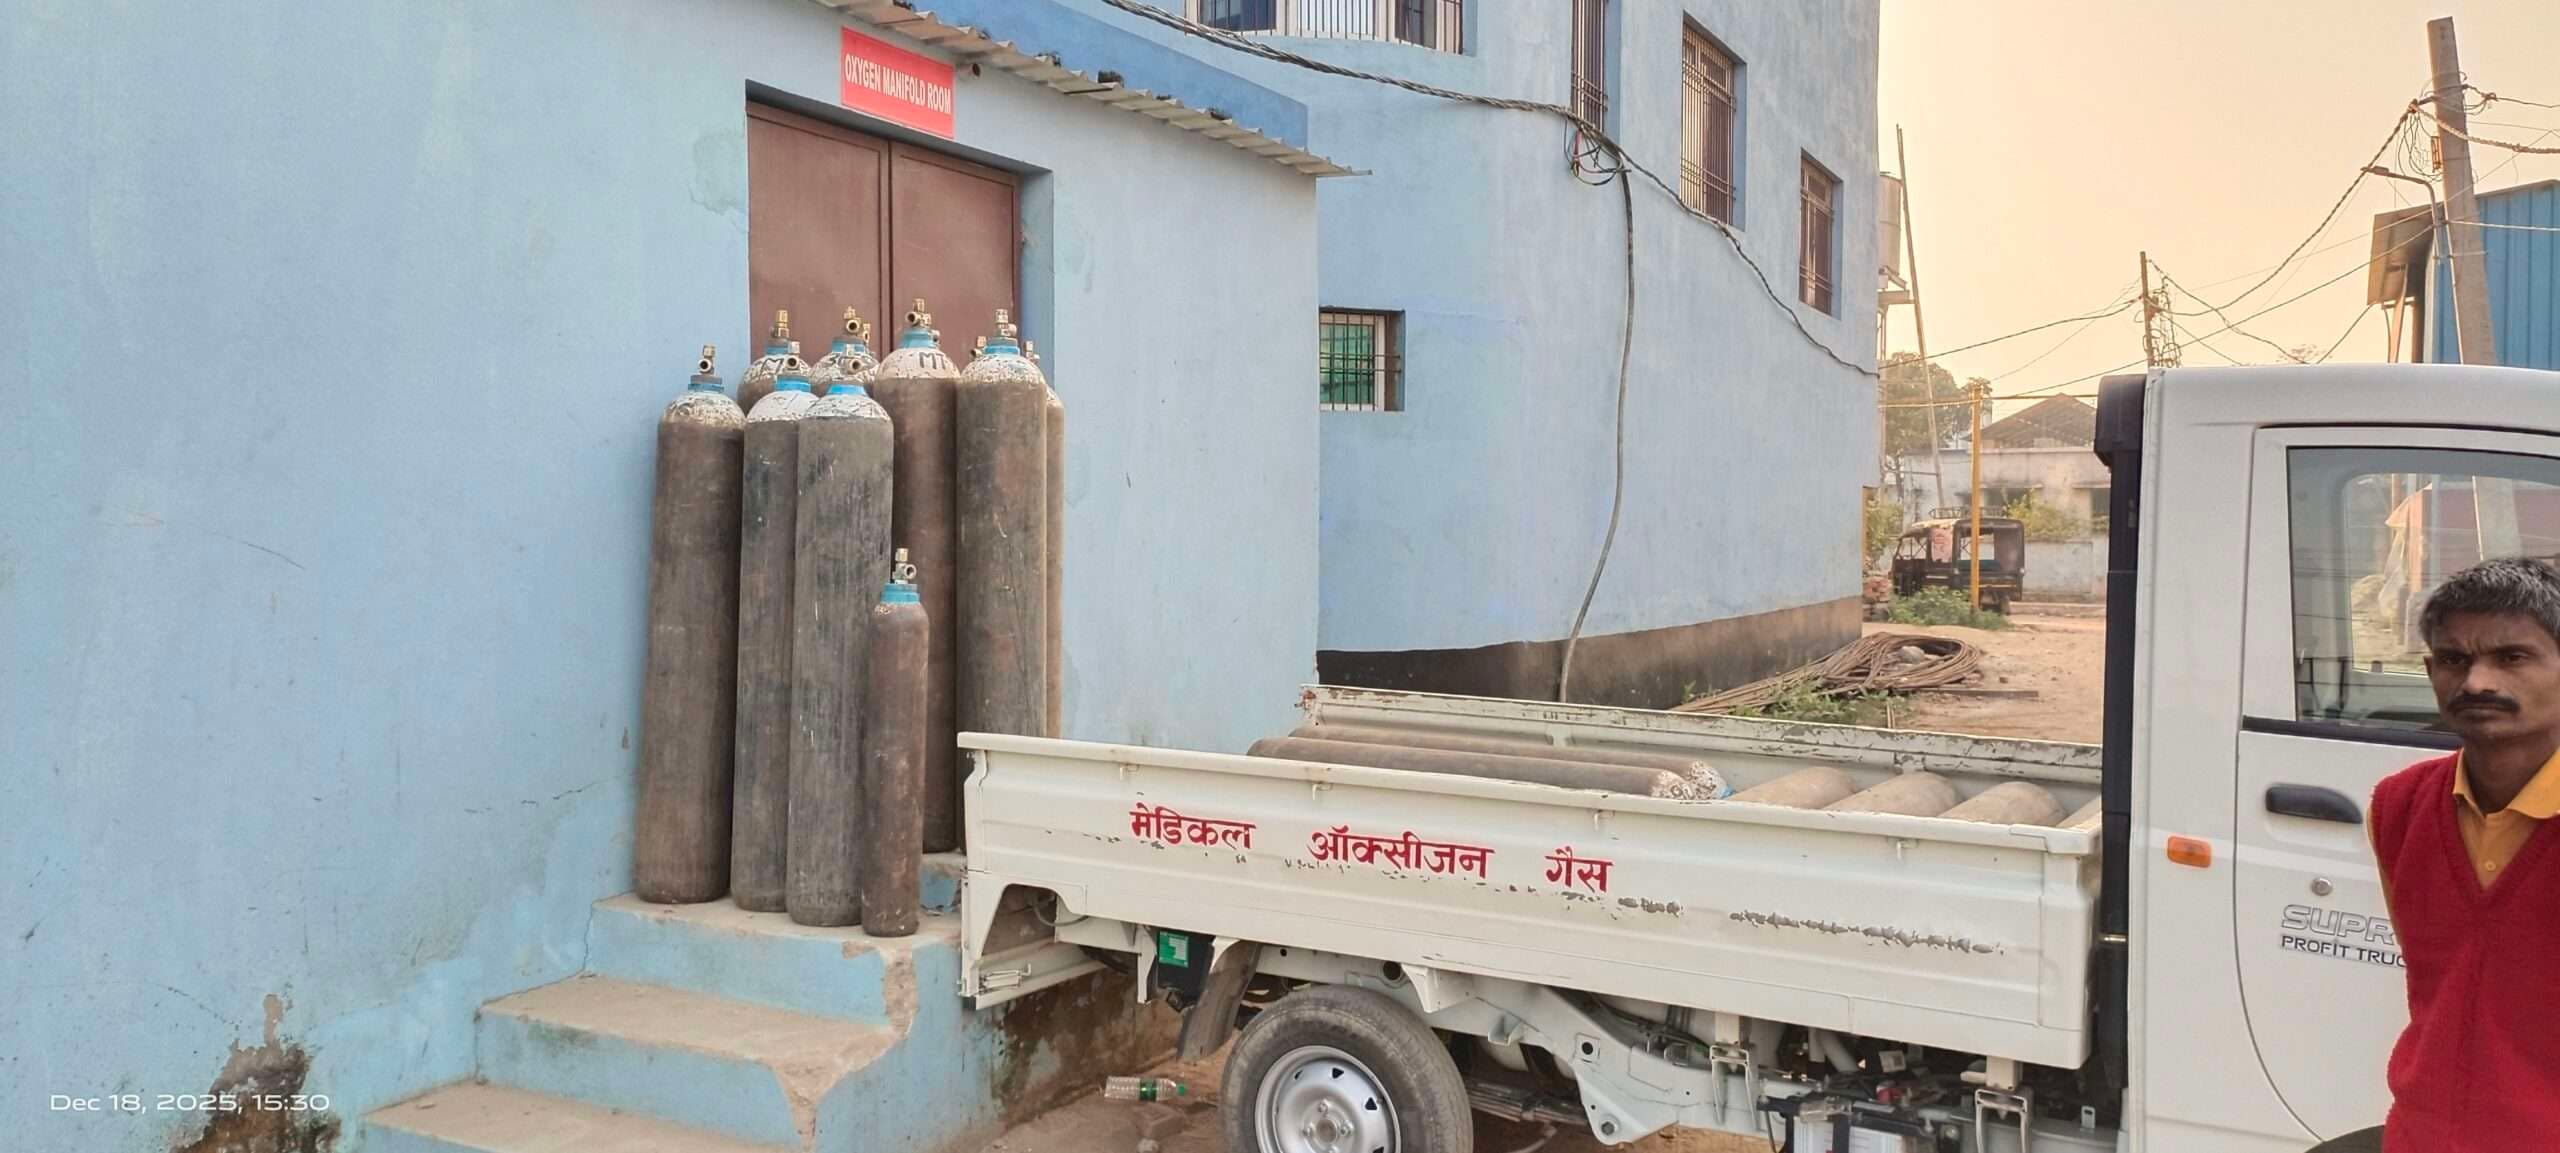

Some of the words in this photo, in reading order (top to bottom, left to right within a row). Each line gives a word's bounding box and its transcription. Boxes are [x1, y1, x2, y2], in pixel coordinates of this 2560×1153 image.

[844, 53, 881, 93] OXYGEN
[882, 66, 926, 106] MANIFOLD
[927, 82, 952, 114] ROOM
[1130, 803, 1256, 848] मेडिकल
[1308, 825, 1494, 878] ऑक्सीजन
[1546, 845, 1614, 892] गैस
[2281, 904, 2395, 946] SUPR
[2281, 935, 2351, 958] PROFIT
[2356, 947, 2407, 968] TRUC
